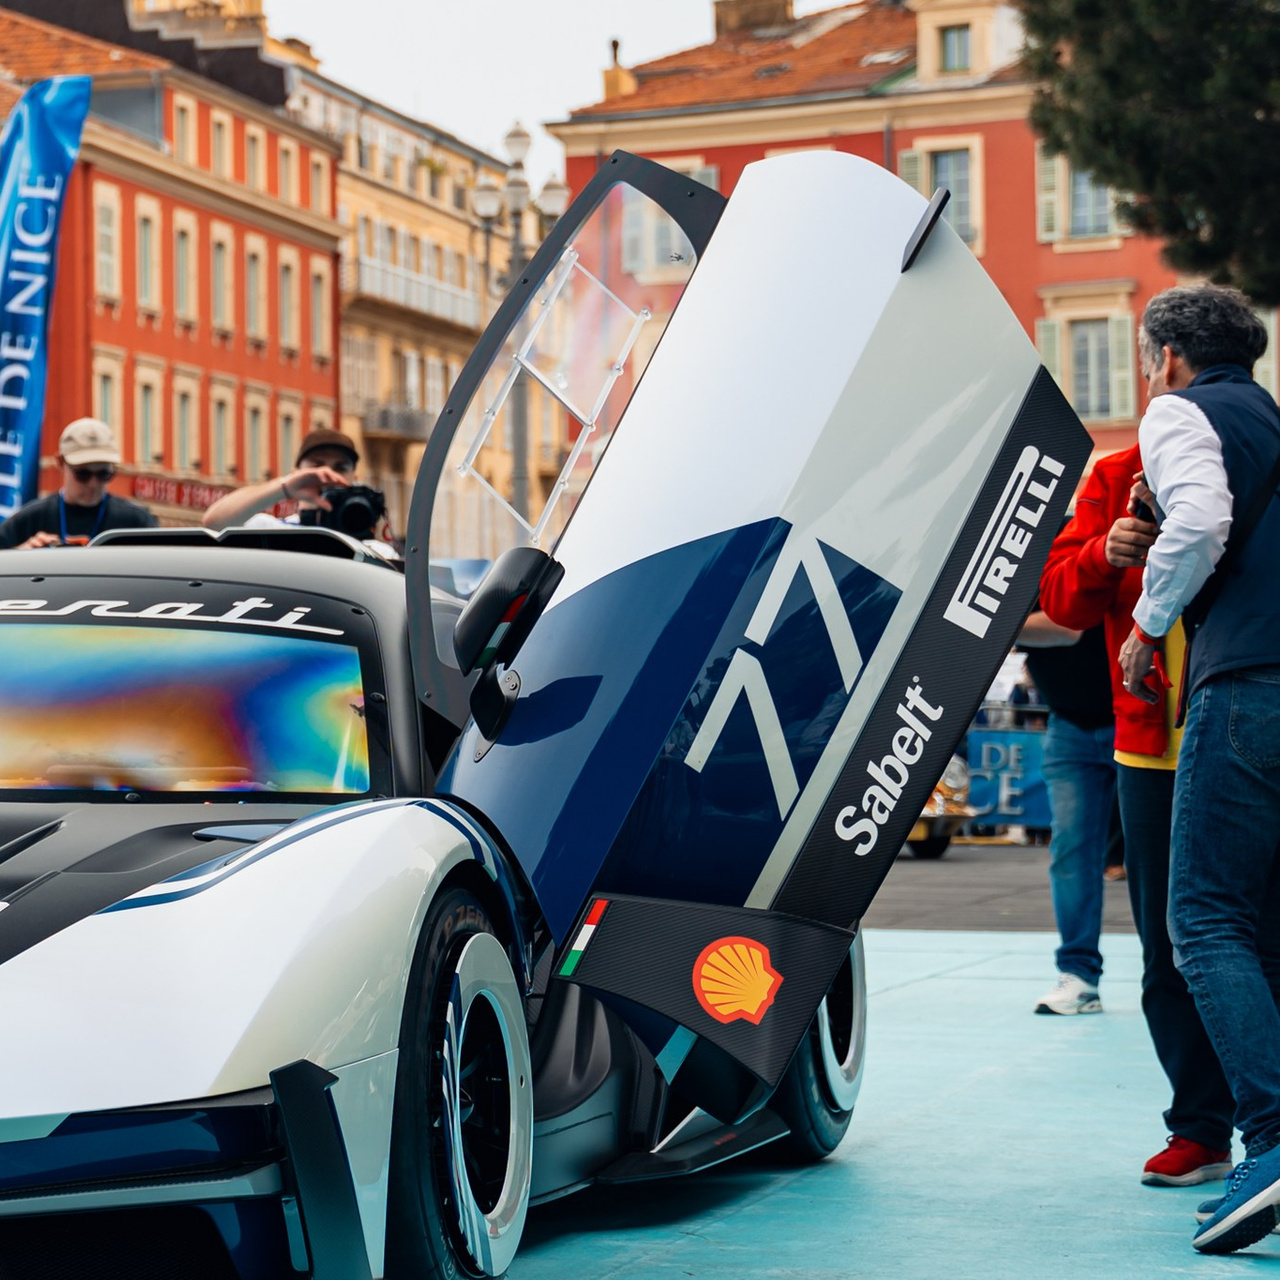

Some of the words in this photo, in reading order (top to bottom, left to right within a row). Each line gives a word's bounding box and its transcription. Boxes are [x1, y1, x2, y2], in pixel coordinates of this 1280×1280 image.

[5, 170, 63, 316] NICE
[943, 445, 1065, 639] PIRELLI
[834, 682, 944, 857] Sabelt
[967, 768, 1024, 815] CE
[981, 741, 1024, 771] DE
